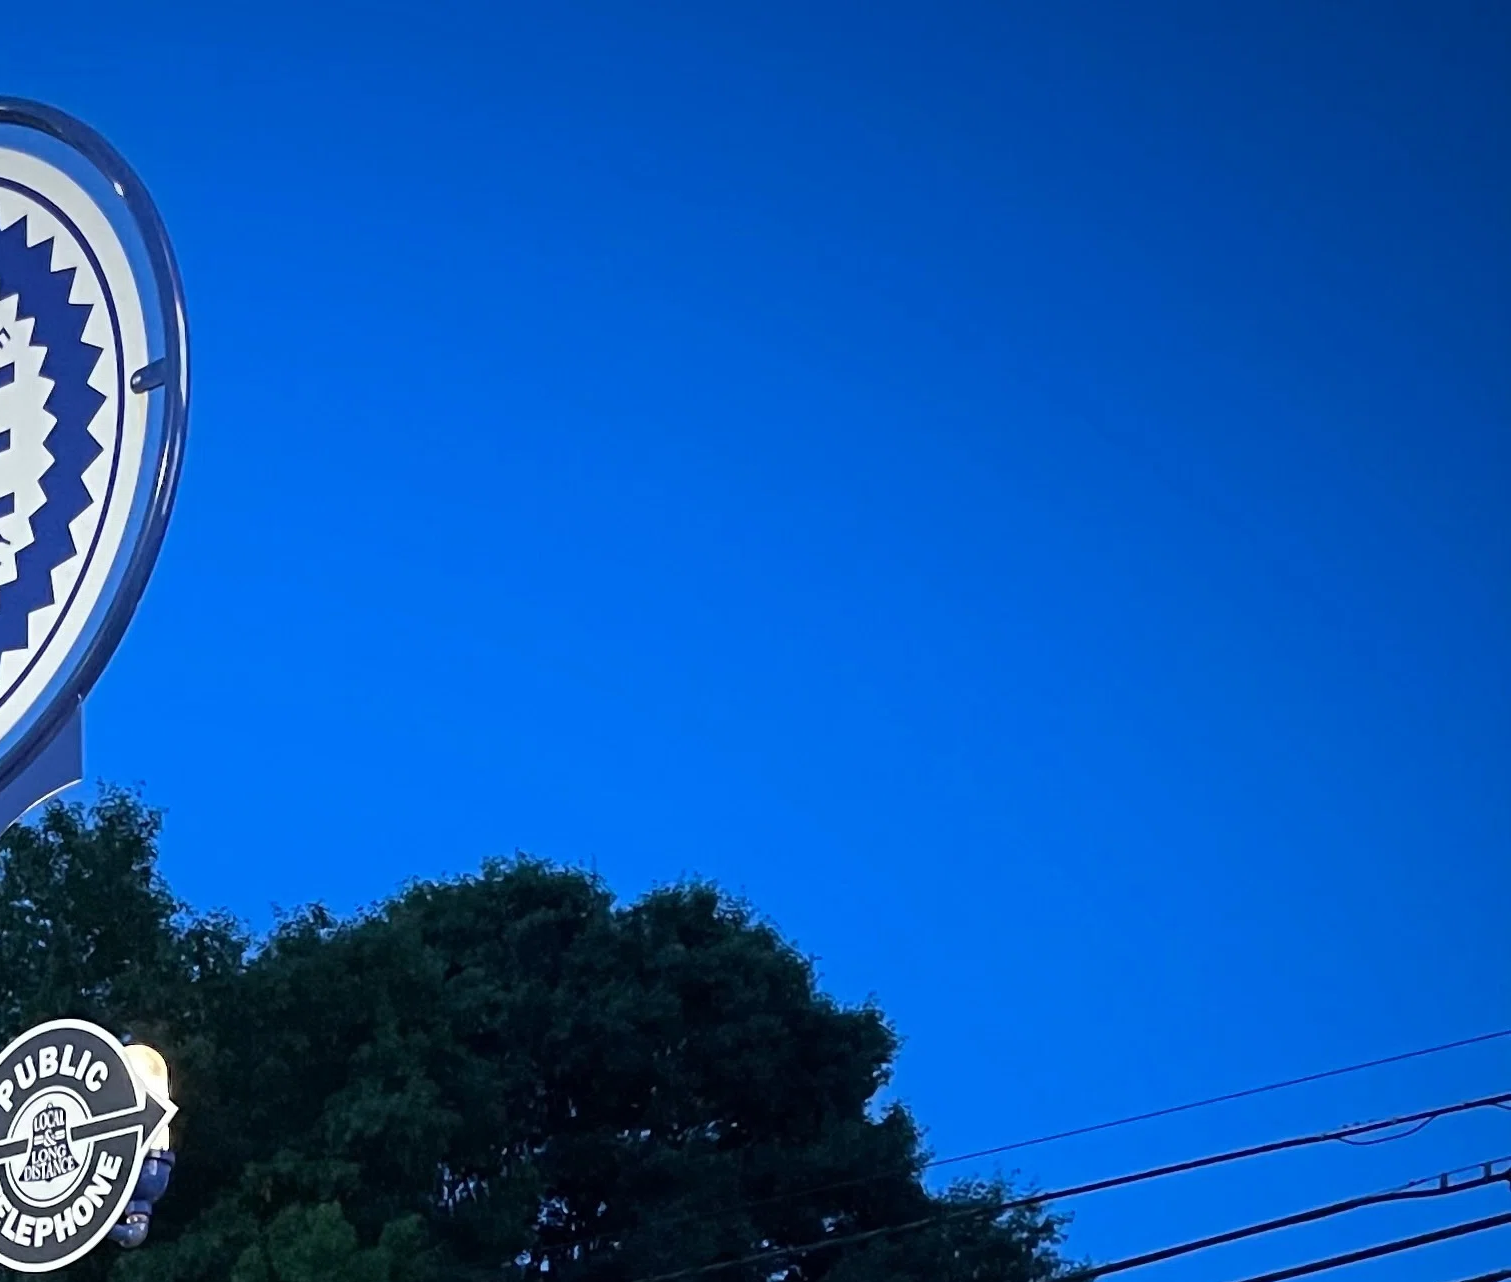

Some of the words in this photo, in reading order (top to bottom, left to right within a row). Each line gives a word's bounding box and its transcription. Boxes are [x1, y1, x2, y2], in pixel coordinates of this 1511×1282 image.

[33, 1109, 65, 1131] LOCAL
[31, 1144, 67, 1163] LONG
[23, 1156, 75, 1182] DISTANCE
